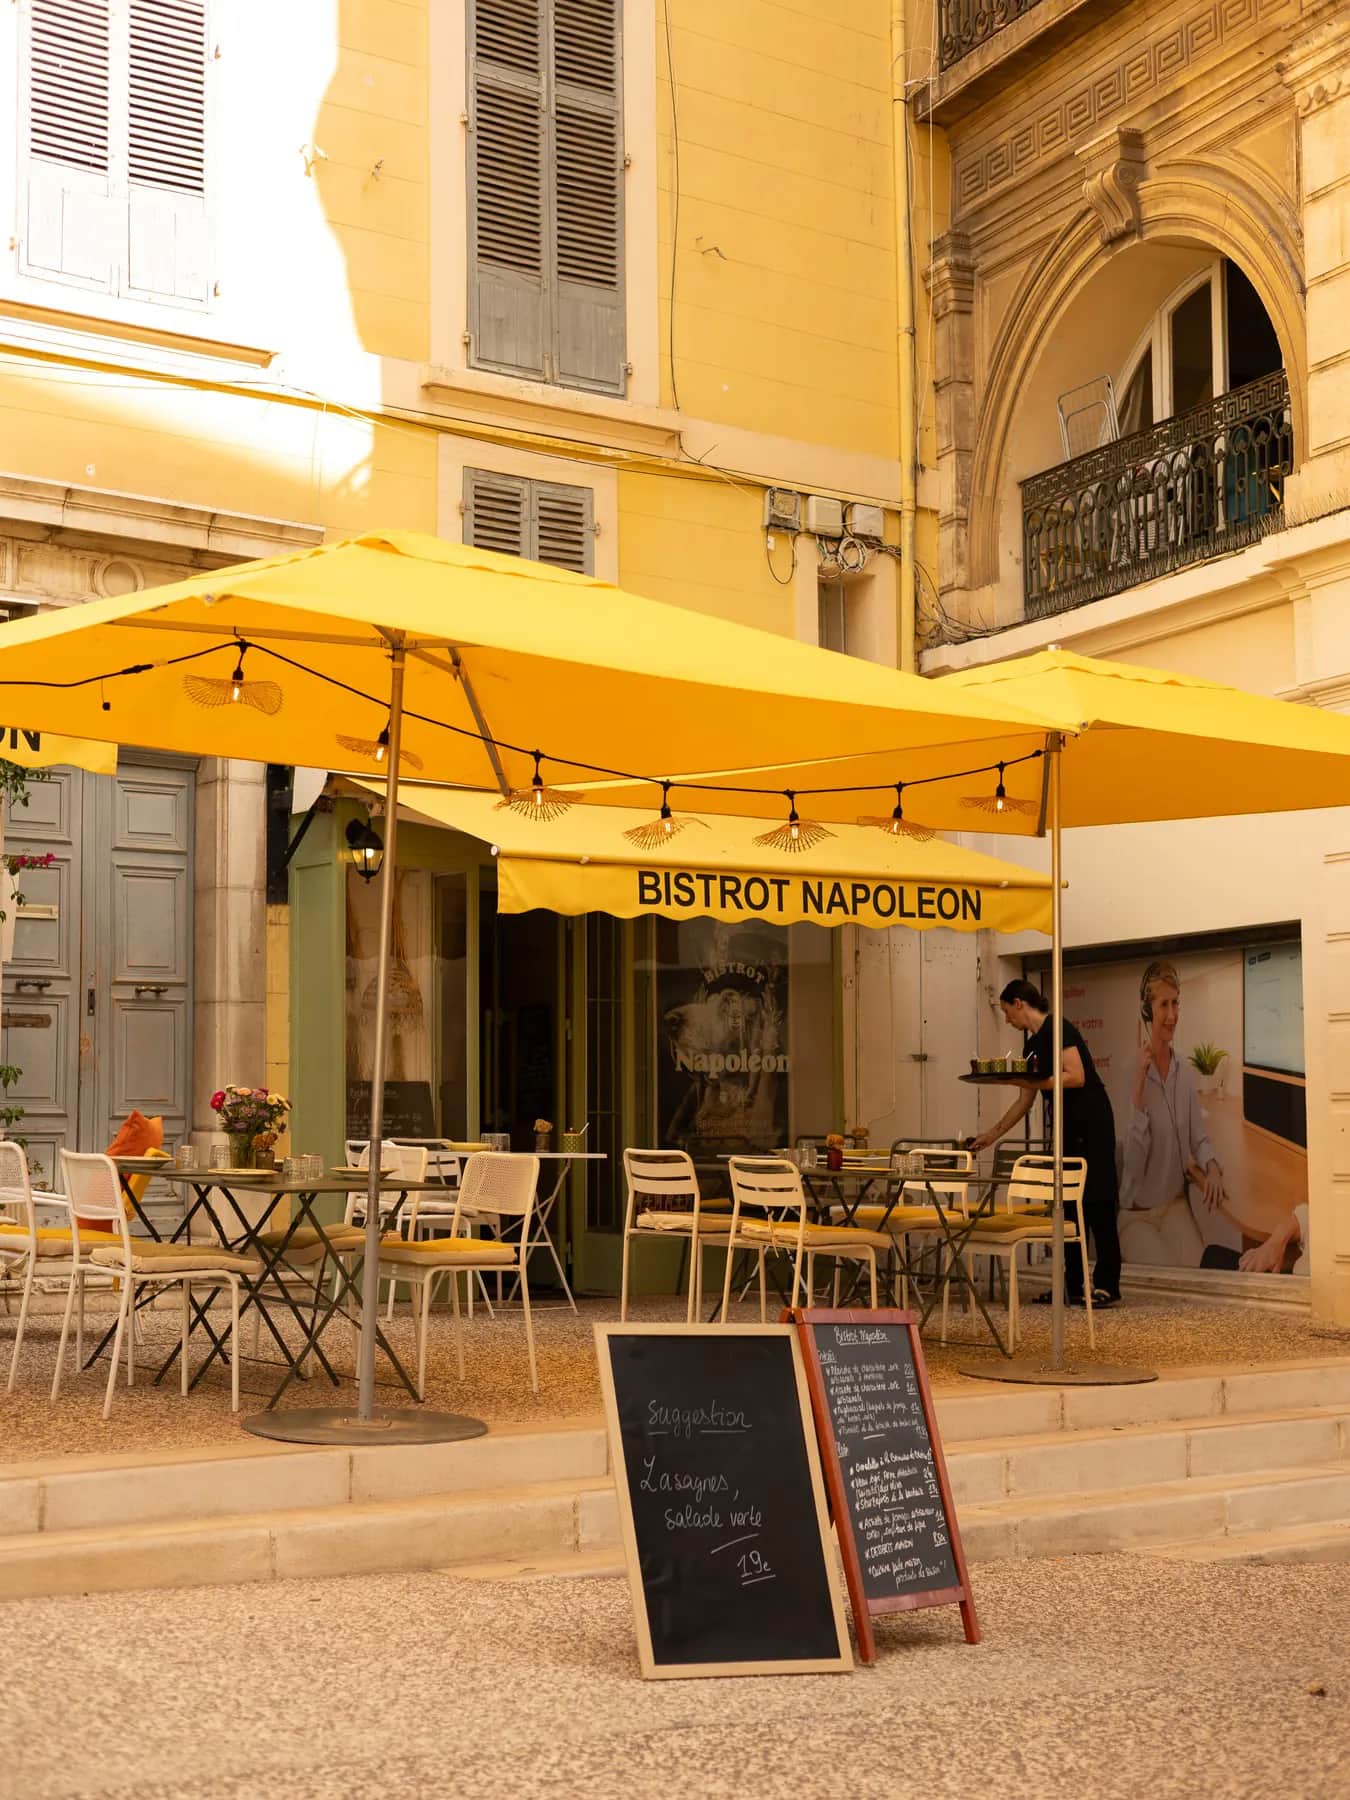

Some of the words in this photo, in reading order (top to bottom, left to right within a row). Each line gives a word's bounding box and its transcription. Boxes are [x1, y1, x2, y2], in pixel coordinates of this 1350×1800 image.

[0, 726, 40, 752] N
[638, 870, 790, 912] BISTROT
[802, 880, 982, 921] NAPOLEON
[648, 1400, 752, 1438] Suggestion
[664, 1504, 724, 1530] salade
[730, 1505, 762, 1527] verte
